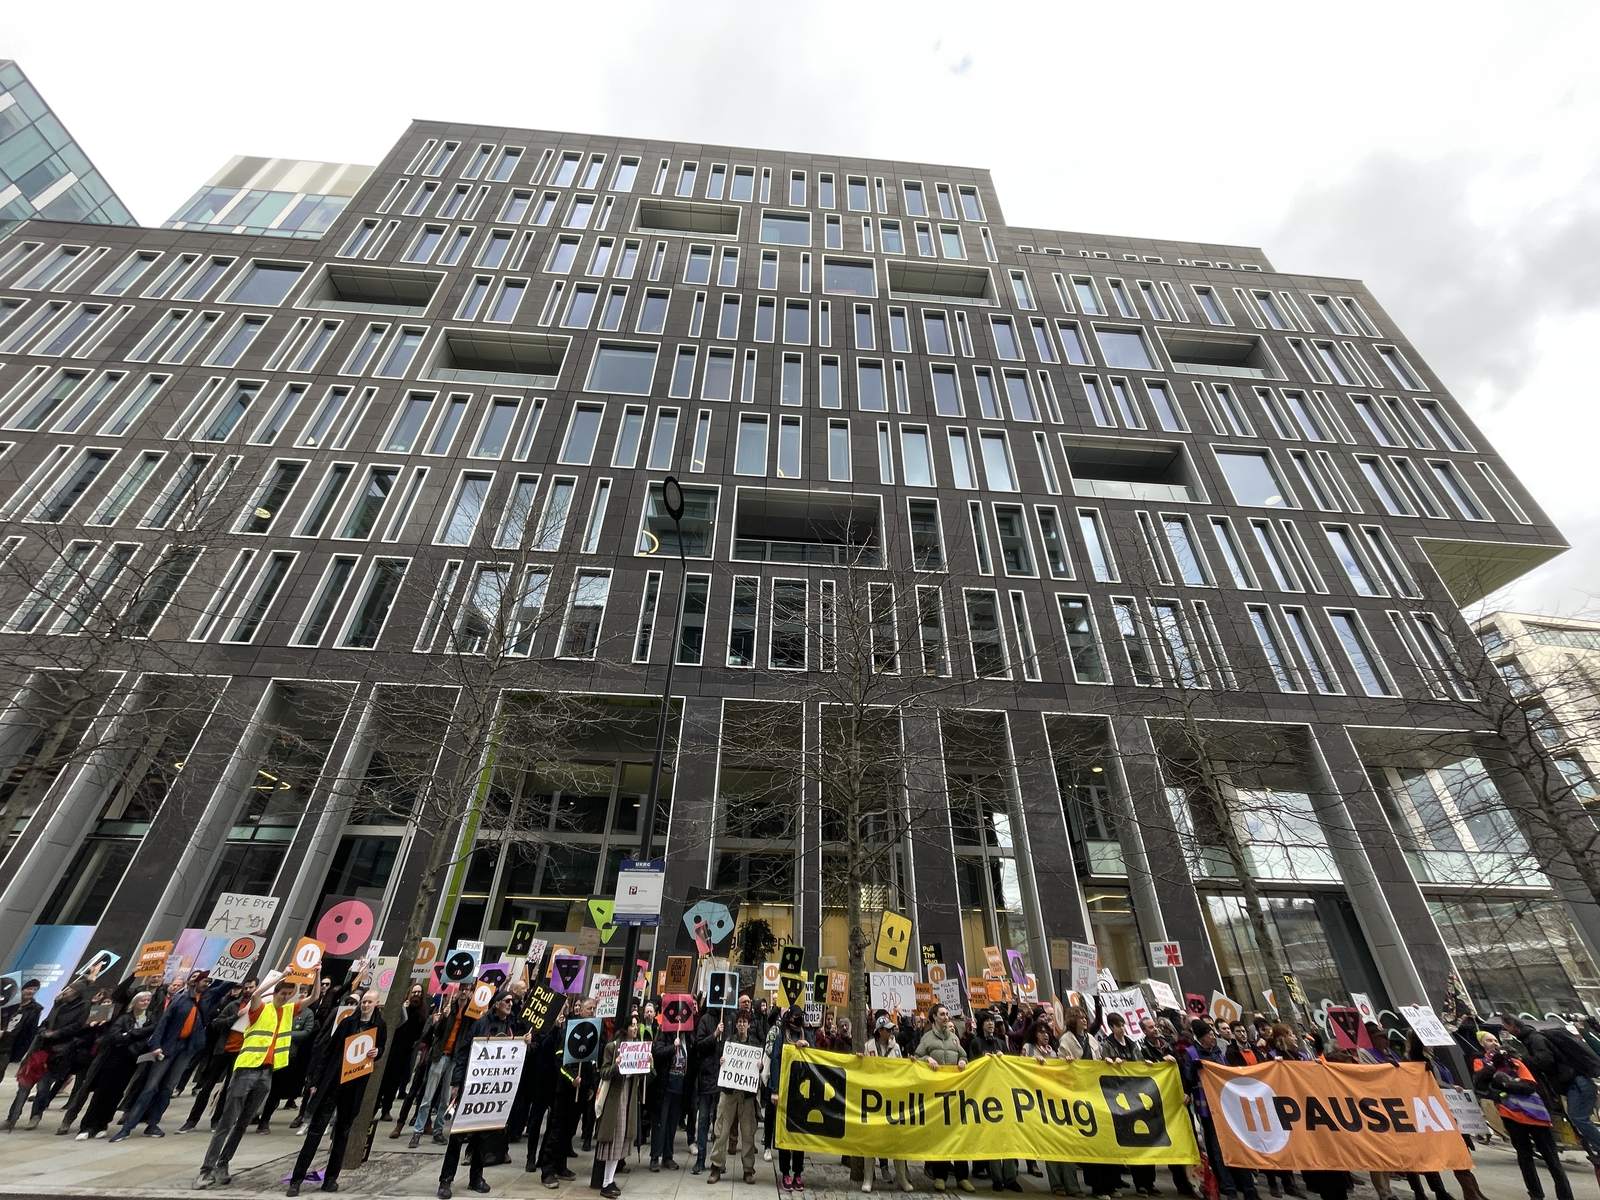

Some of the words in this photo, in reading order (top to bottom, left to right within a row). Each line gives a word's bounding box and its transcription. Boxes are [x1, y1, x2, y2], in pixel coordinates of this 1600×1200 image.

[224, 895, 249, 907] BYE
[253, 898, 275, 909] BYE
[142, 951, 167, 960] BEFORE
[216, 955, 251, 971] REGULATE
[212, 967, 245, 980] NOW
[872, 975, 913, 986] EXTINCTION
[600, 979, 620, 987] GREED
[534, 986, 554, 1003] Pull
[831, 989, 845, 997] DON'T
[881, 991, 902, 1008] BAD
[529, 997, 548, 1014] The
[1109, 996, 1118, 1008] is
[1120, 994, 1135, 1007] the
[521, 1007, 545, 1029] Plug
[732, 1047, 748, 1058] FUCK
[637, 1060, 650, 1069] DIE
[728, 1058, 745, 1069] FUCK
[745, 1061, 752, 1070] IT
[472, 1067, 500, 1077] OVER
[502, 1066, 518, 1076] MY
[723, 1070, 733, 1080] TO
[733, 1072, 759, 1089] DEATH
[468, 1081, 513, 1096] DEAD
[461, 1100, 508, 1116] BODY
[861, 1088, 925, 1127] Pull
[934, 1089, 1005, 1127] The
[1012, 1087, 1097, 1138] Plug
